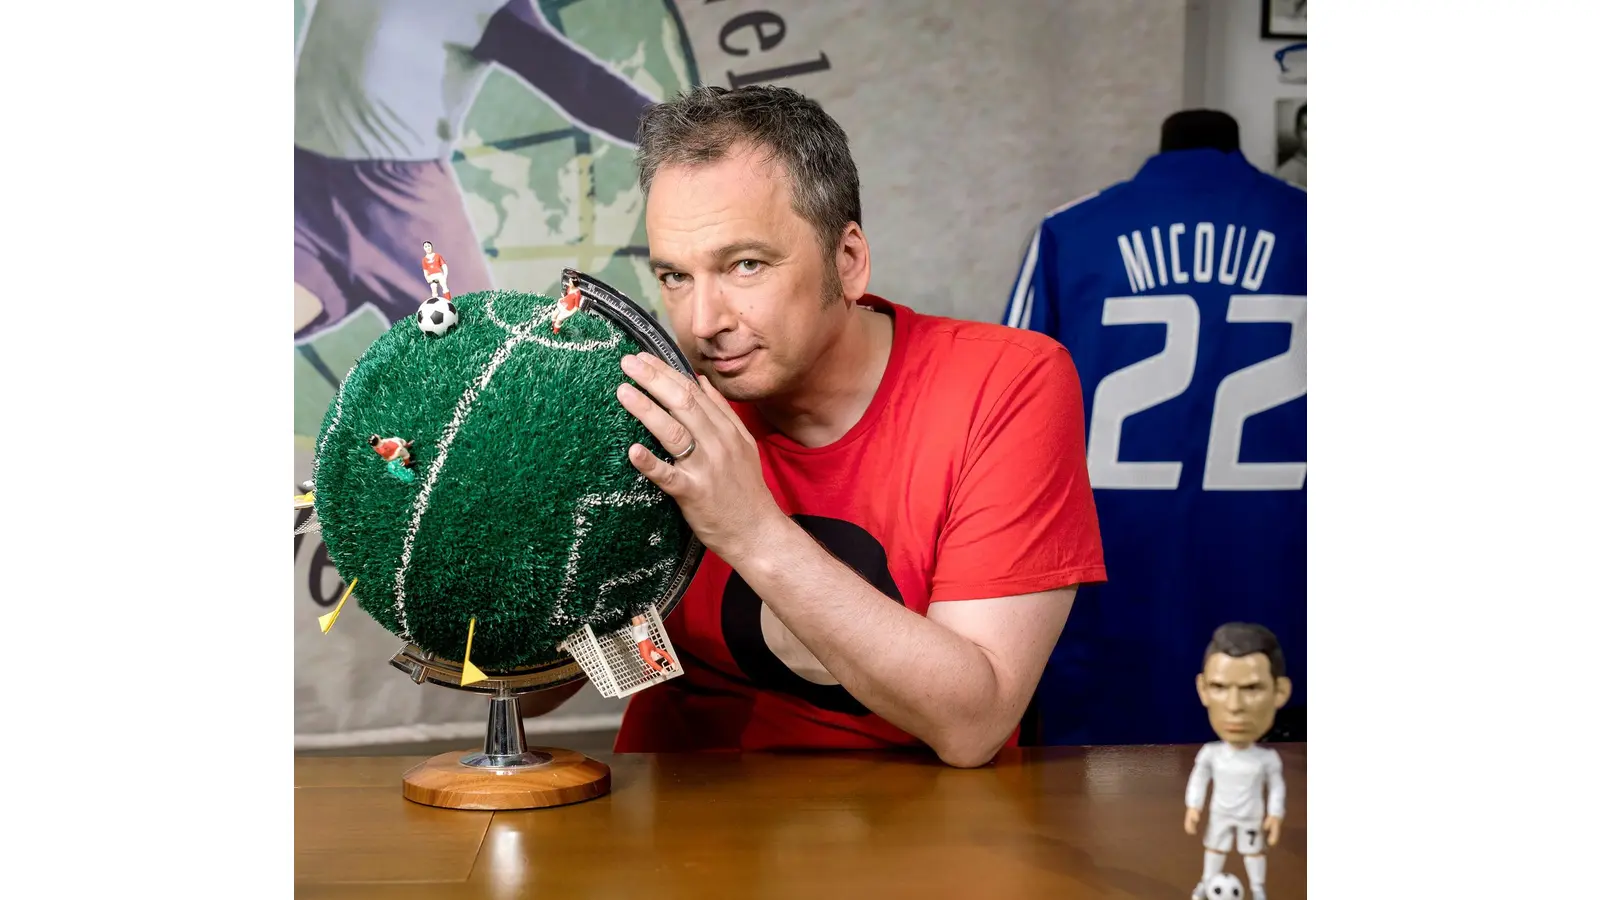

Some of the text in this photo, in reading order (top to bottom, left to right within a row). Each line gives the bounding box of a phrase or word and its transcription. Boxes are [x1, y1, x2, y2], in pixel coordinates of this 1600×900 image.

[704, 0, 831, 92] el
[1117, 222, 1276, 294] MICOUD
[1087, 294, 1307, 491] 22
[1246, 829, 1258, 847] 7
